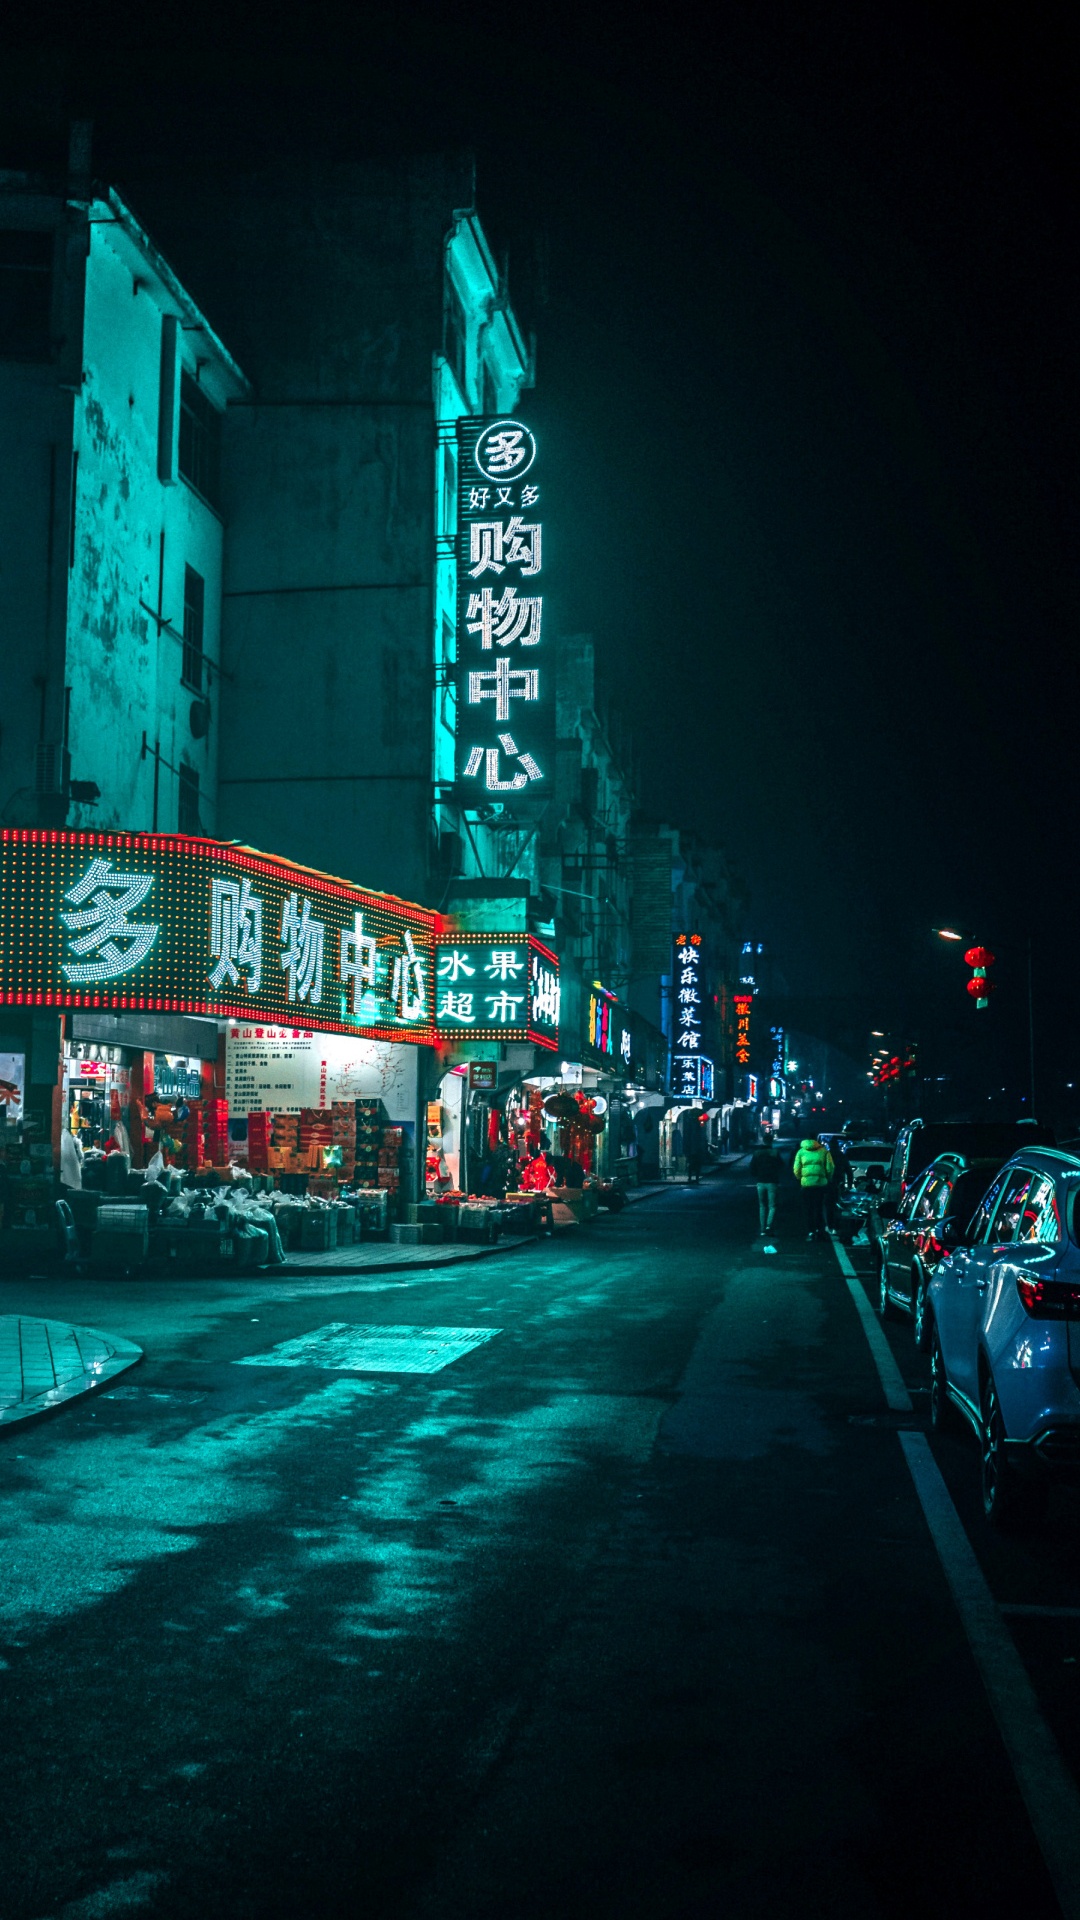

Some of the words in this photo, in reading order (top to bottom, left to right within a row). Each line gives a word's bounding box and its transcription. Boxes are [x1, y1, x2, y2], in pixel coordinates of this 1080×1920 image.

[486, 430, 526, 473] 多
[469, 484, 540, 510] 好又多
[463, 516, 544, 791] 购物中心
[60, 858, 159, 983] 多
[437, 950, 525, 981] 水果
[437, 991, 525, 1024] 超市
